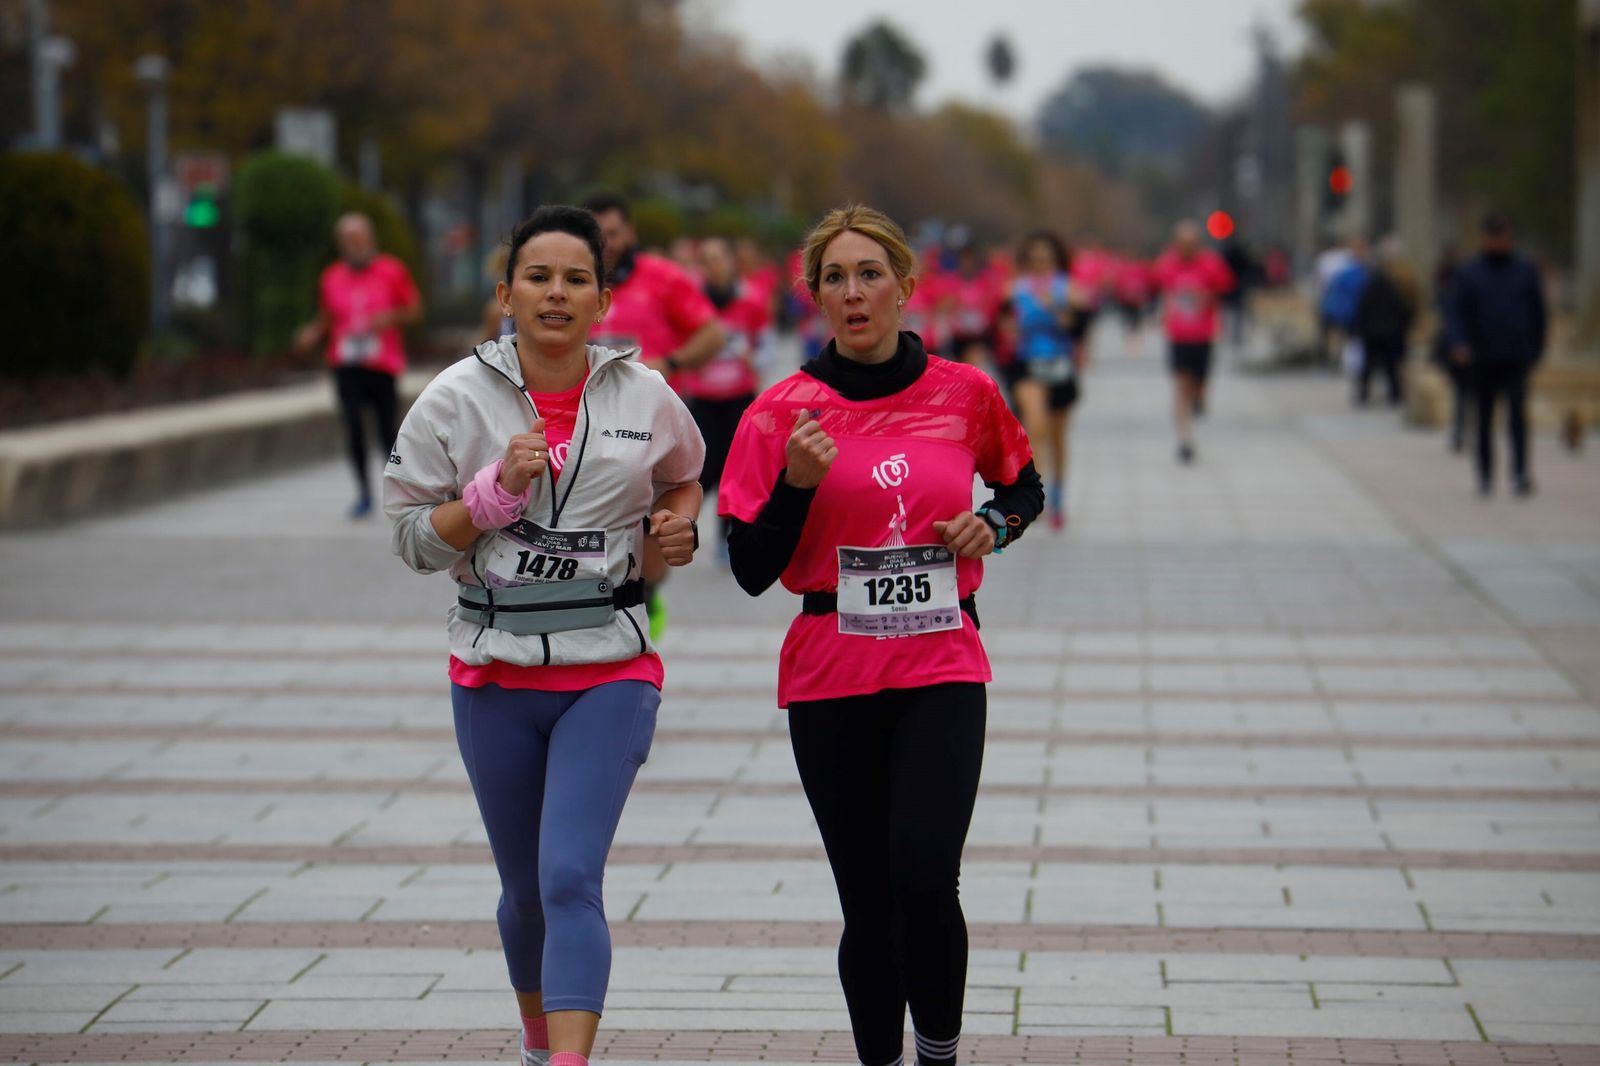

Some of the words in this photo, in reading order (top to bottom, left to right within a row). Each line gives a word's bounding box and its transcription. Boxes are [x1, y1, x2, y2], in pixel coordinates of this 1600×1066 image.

[614, 429, 653, 442] TERREX
[541, 534, 568, 542] BUENOS
[516, 550, 579, 581] 1478
[863, 573, 931, 606] 1235
[891, 605, 908, 613] Sonia
